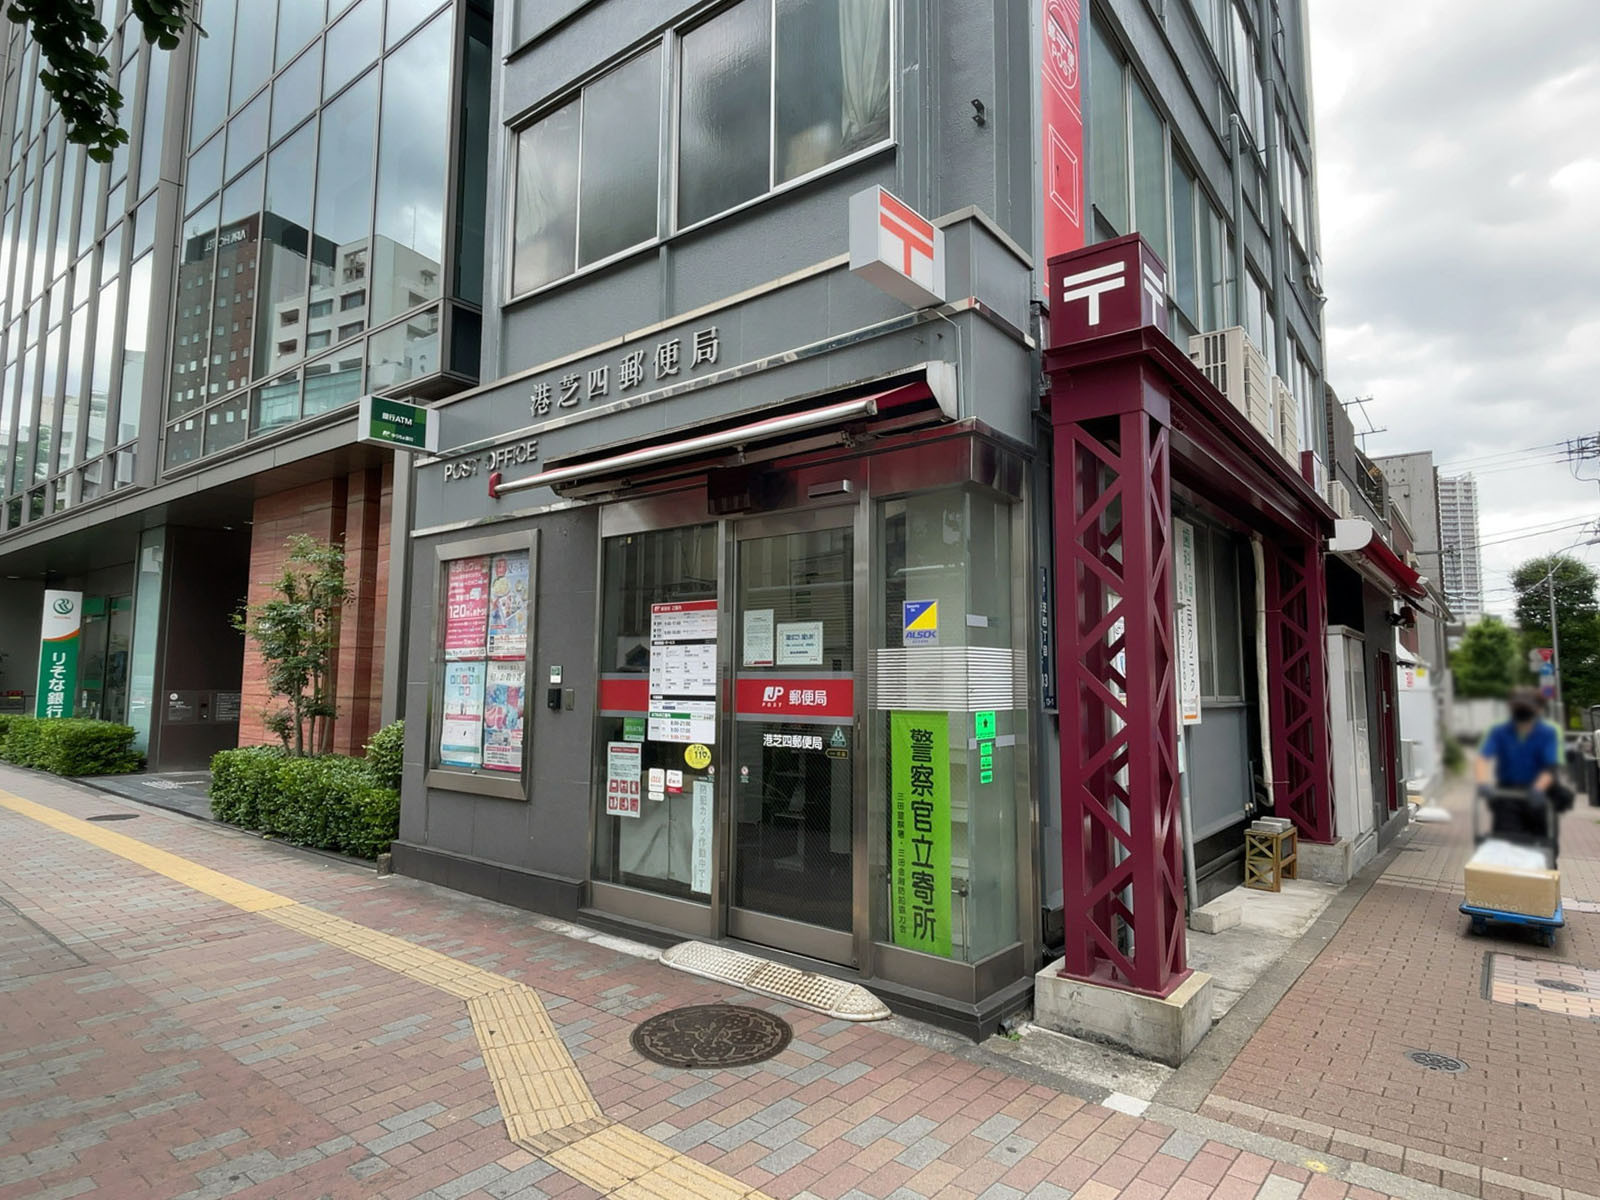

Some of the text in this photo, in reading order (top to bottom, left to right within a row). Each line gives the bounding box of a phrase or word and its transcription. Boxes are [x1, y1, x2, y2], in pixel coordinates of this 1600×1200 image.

[530, 326, 719, 417] 港芝四郵便局
[444, 440, 538, 482] POST OFFICE
[905, 630, 937, 639] ALSOK
[46, 652, 67, 718] りそな銀行
[789, 689, 827, 706] 郵便局
[763, 733, 823, 750] 港芝四郵便局
[910, 728, 936, 942] 警察官立寄所
